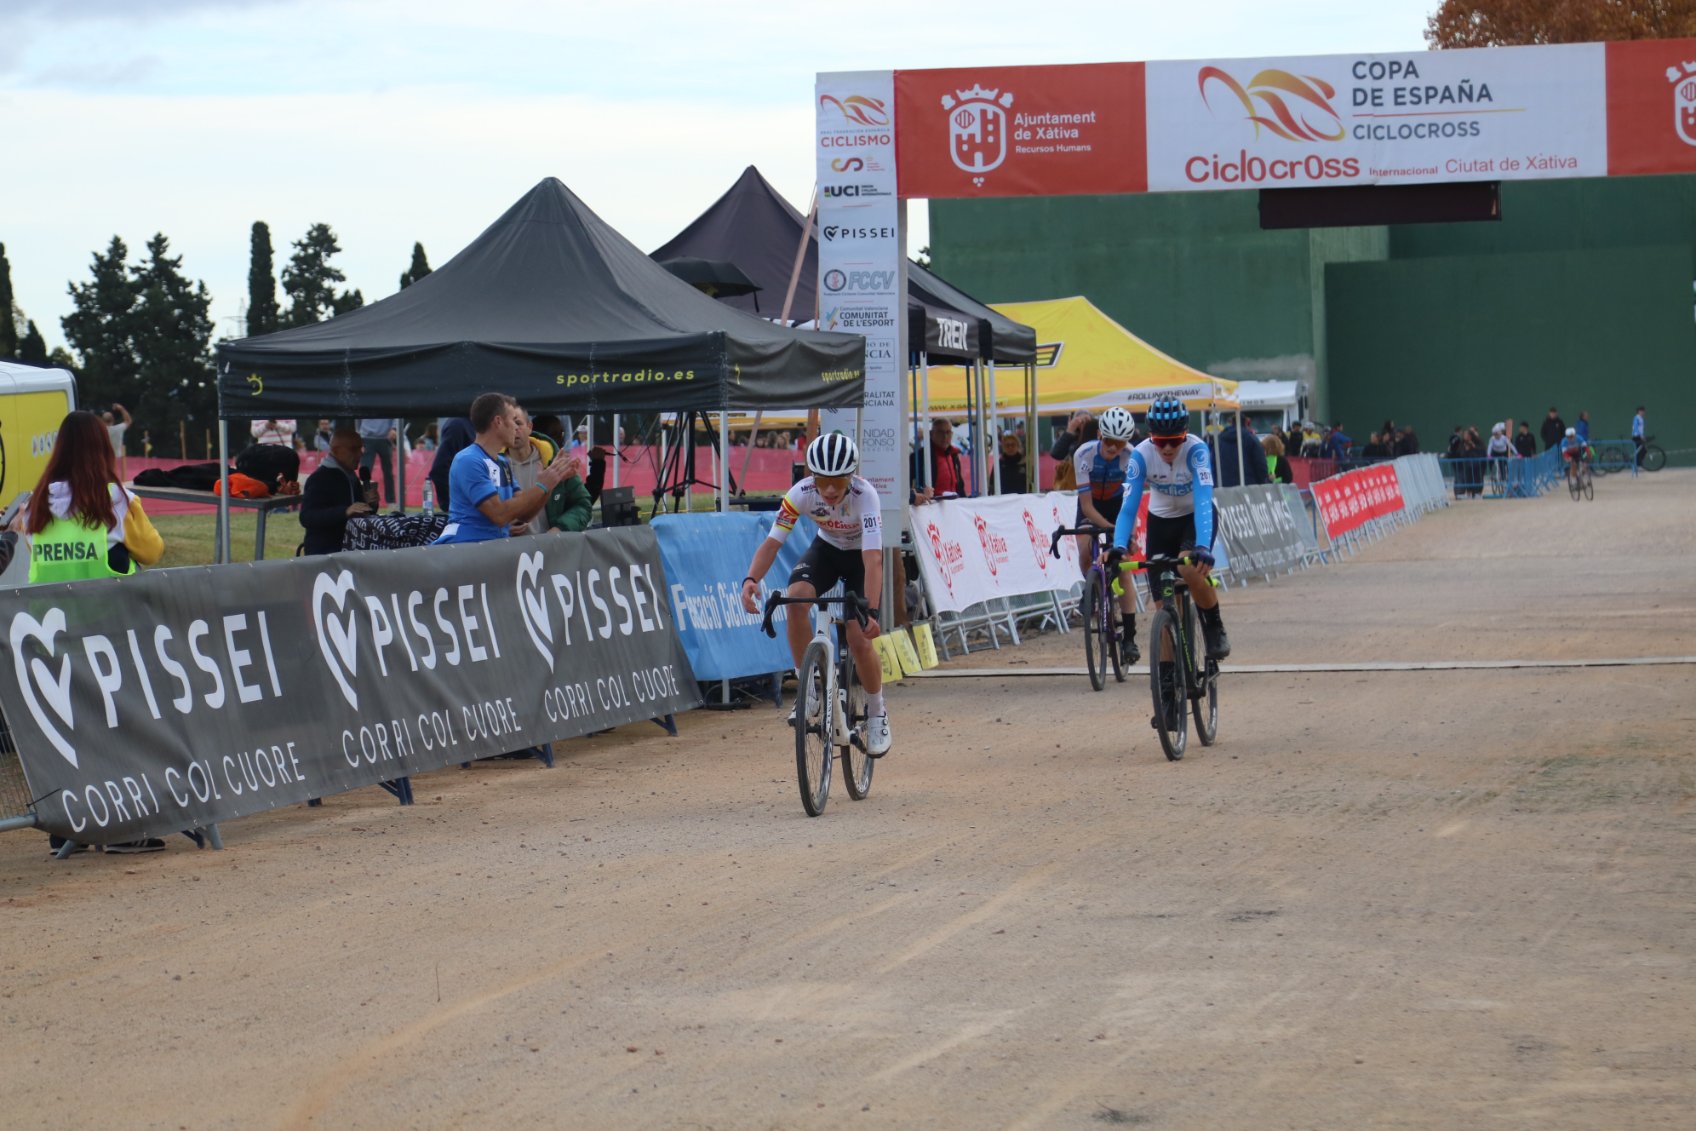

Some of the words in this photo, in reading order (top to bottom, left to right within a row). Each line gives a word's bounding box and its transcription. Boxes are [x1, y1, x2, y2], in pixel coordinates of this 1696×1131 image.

[1352, 60, 1419, 80] COPA
[1352, 88, 1384, 107] DE
[1393, 78, 1494, 104] ESPAÑA
[1014, 110, 1096, 126] Ajuntament
[1014, 128, 1030, 140] de
[1035, 126, 1079, 140] Xàtiva
[1352, 120, 1480, 140] CICLOCROSS
[821, 135, 890, 148] CICLISMO
[1015, 144, 1054, 154] Recursos
[1056, 142, 1092, 152] Humans
[1369, 165, 1439, 176] Internacional
[1446, 158, 1495, 174] Ciutat
[1498, 156, 1520, 172] de
[830, 185, 859, 197] UCI
[842, 228, 894, 238] PISSEI
[848, 271, 895, 290] FCCV
[840, 312, 888, 320] COMUNITAT
[556, 368, 696, 387] sportradio.es
[864, 517, 877, 528] 201
[32, 541, 99, 562] PRENSA
[551, 563, 664, 646] PISSEI
[364, 582, 500, 677] PISSEI
[82, 611, 282, 728] PISSEI
[544, 681, 596, 724] CORRI
[596, 674, 631, 711] COL
[632, 664, 680, 703] CUORE
[342, 717, 414, 768] CORRI
[418, 710, 457, 751] COL
[462, 697, 522, 742] CUORE
[62, 772, 160, 833] CORRI
[165, 760, 221, 808] COL
[223, 742, 305, 796] CUORE
